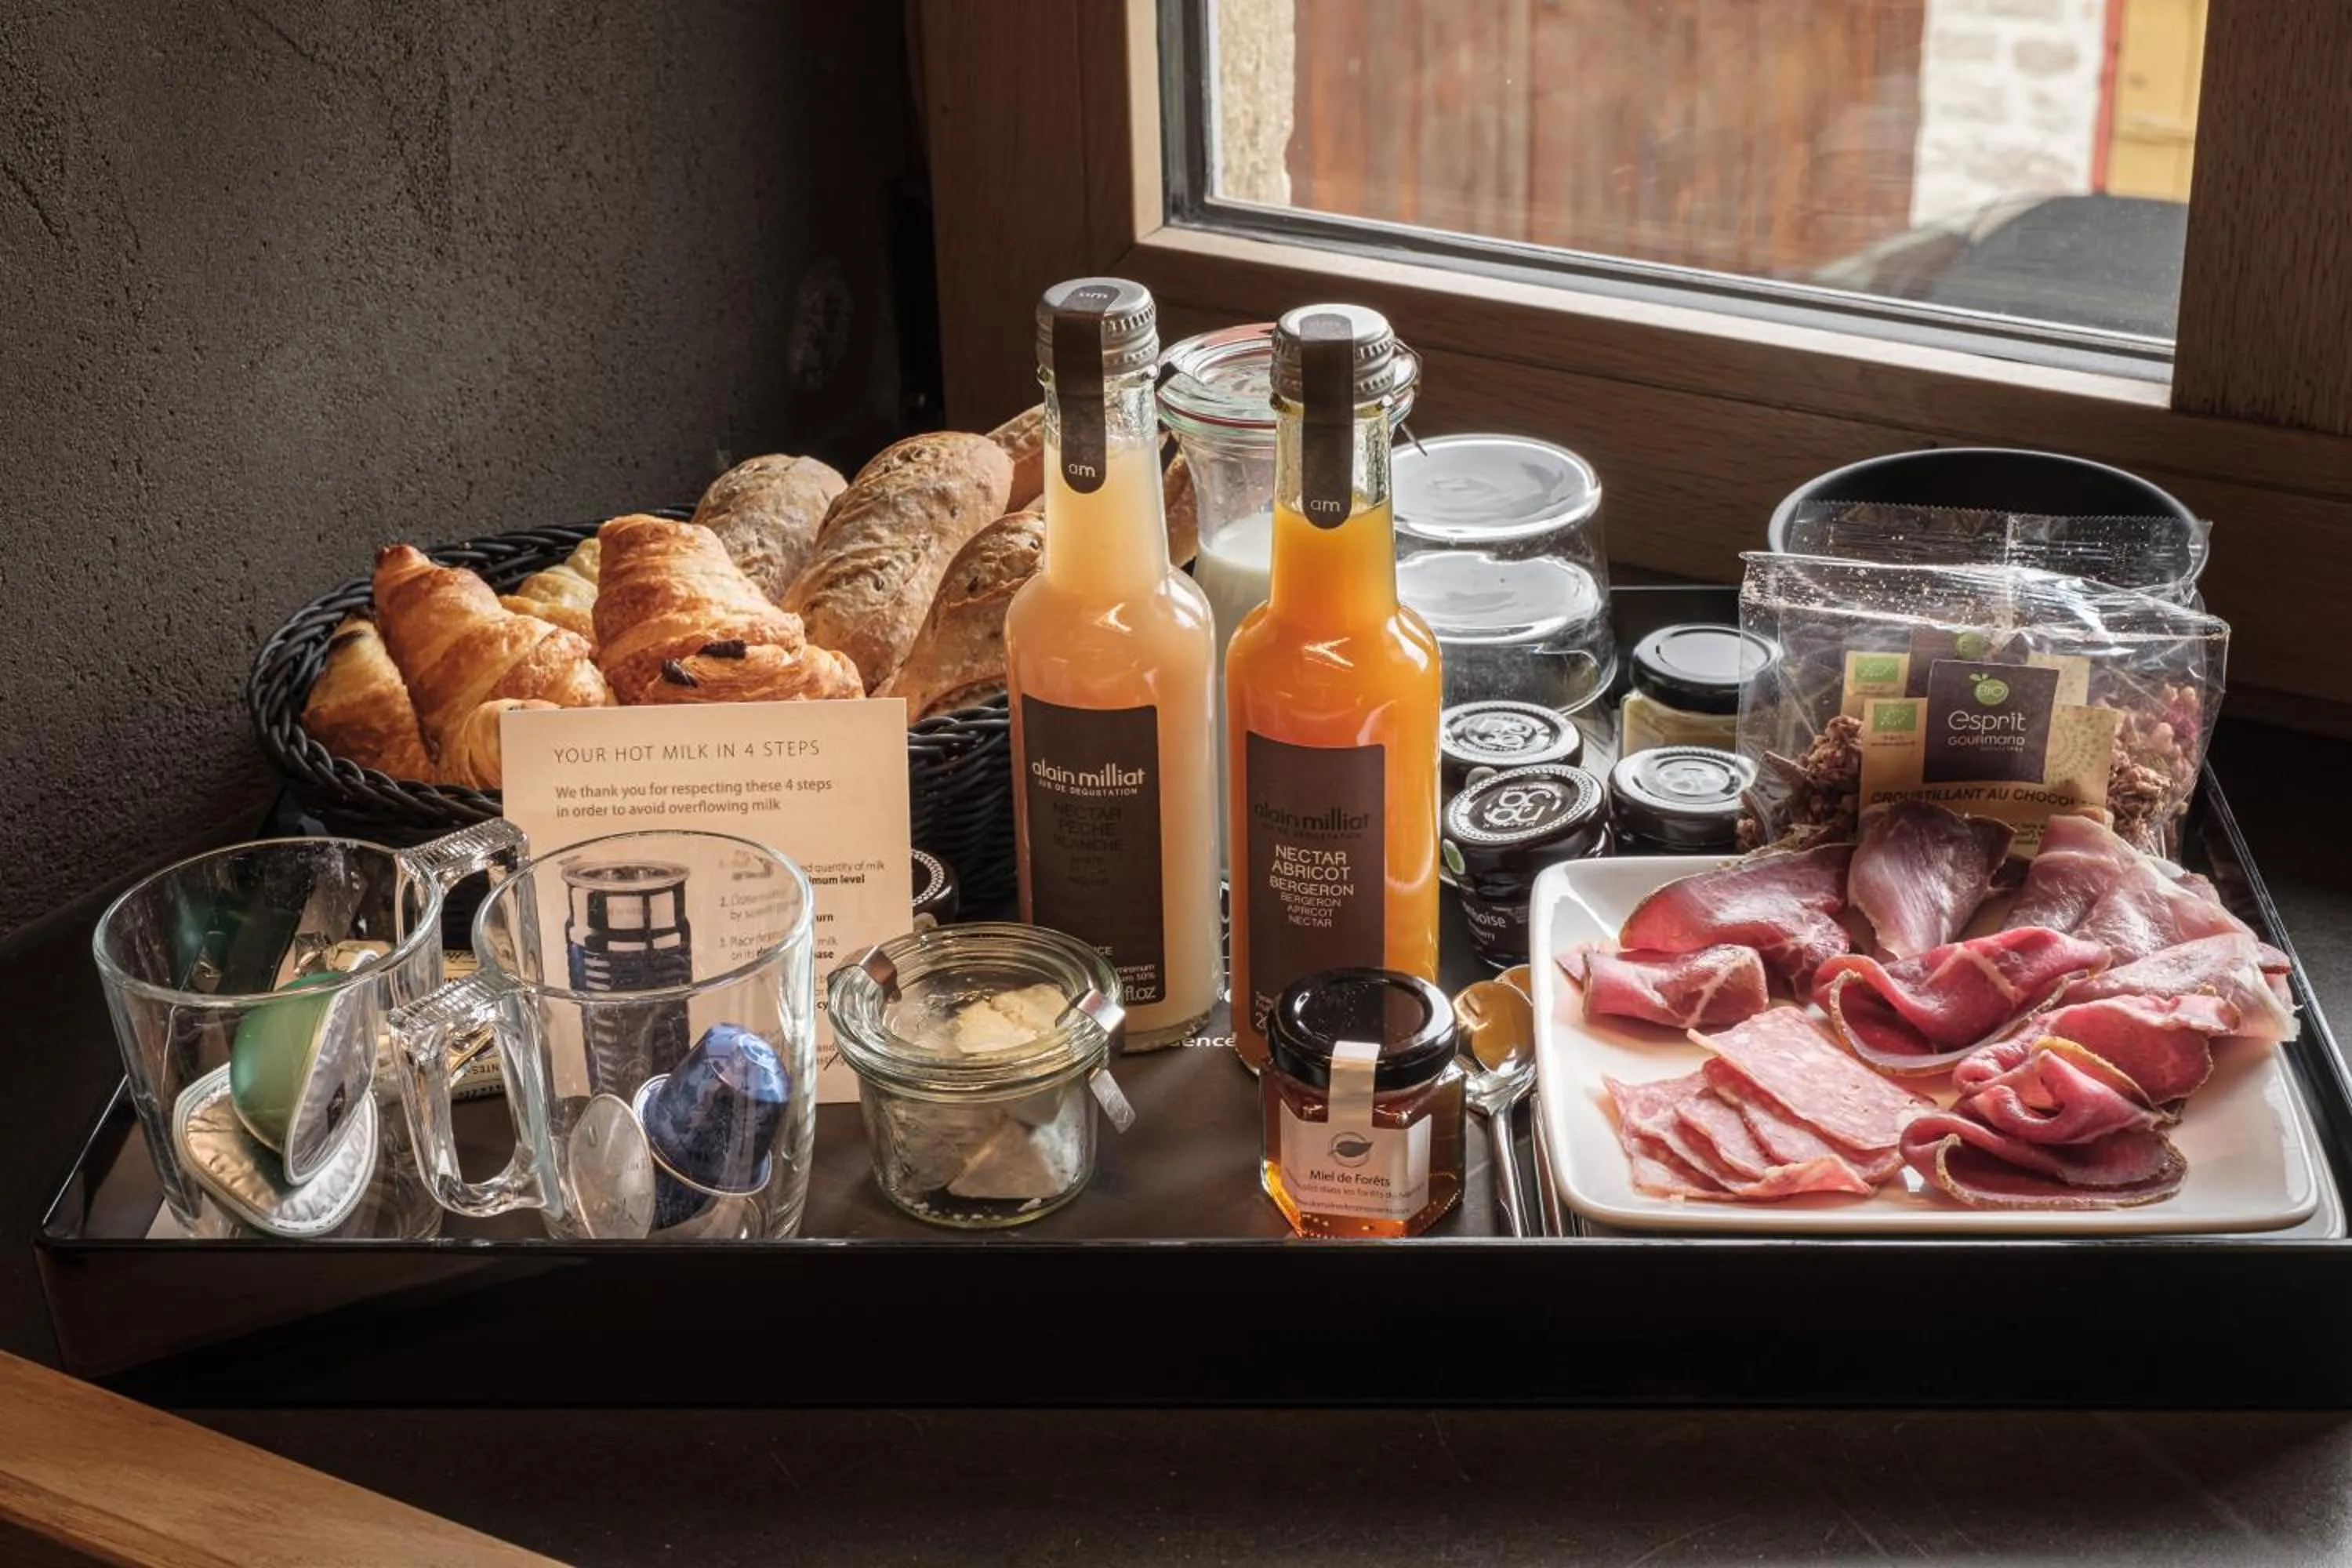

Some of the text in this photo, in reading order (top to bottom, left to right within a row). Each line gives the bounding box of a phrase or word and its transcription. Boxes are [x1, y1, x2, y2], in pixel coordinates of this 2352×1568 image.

[1069, 463, 1095, 477] am
[1310, 499, 1340, 512] am
[1947, 710, 2026, 734] esprit
[554, 740, 821, 764] YOUR HOT MILK IN 4 STEPS
[1032, 757, 1145, 787] alain milliat
[556, 779, 833, 799] We thank you for respecting these 4 steps
[1987, 789, 2009, 801] AU
[556, 798, 781, 818] in order to avoid overflowing milk
[1275, 844, 1347, 865] NECTAR
[840, 874, 865, 884] level
[1271, 860, 1351, 880] ABRICOT
[1269, 875, 1355, 896] BERGERON
[1280, 892, 1342, 907] BERGERON
[1287, 905, 1334, 917] APRICOT
[1288, 914, 1333, 927] NECTAR
[1309, 1170, 1391, 1187] Miel de Forêts
